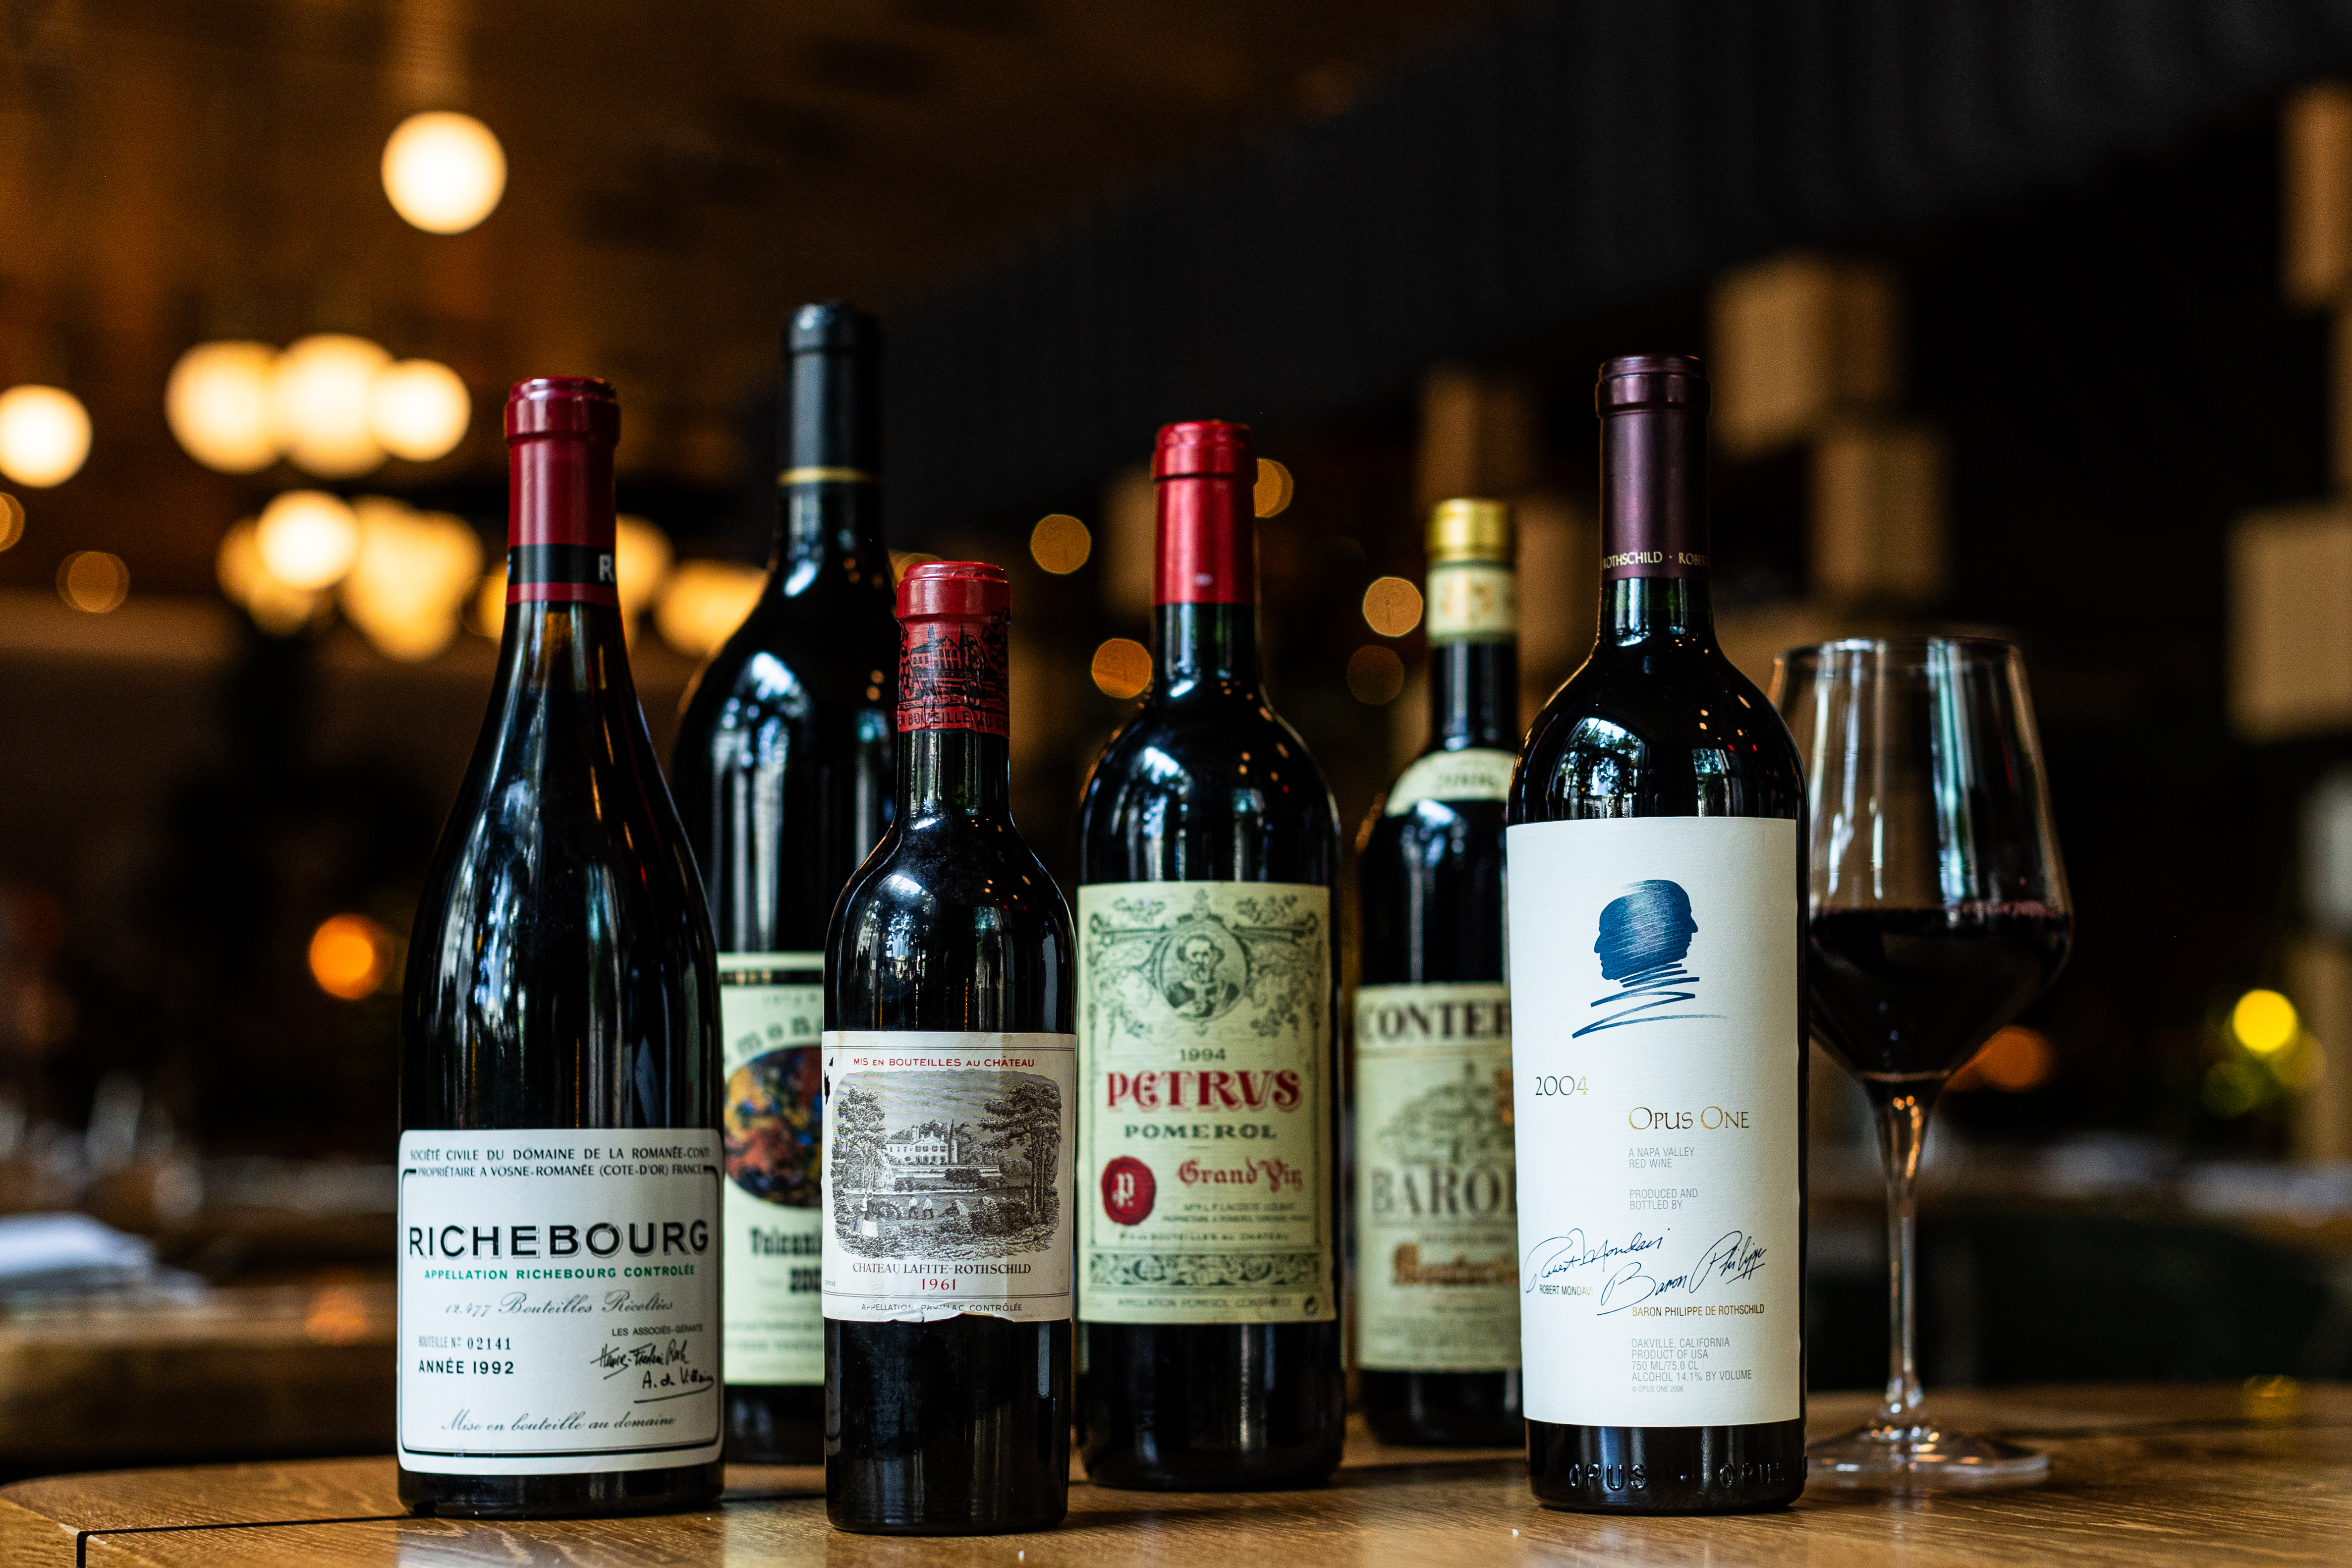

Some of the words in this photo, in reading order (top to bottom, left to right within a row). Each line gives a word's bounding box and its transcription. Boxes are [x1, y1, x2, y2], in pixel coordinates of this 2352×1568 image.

[1603, 551, 1663, 569] ROTHSCHILD
[853, 1058, 868, 1066] MIS
[889, 1058, 962, 1067] BOUTEILLES
[984, 1056, 1035, 1067] CHÂTEAU
[1179, 1048, 1227, 1062] 1994
[1535, 1076, 1588, 1096] 2004
[1629, 1107, 1693, 1130] OPUS
[1700, 1106, 1750, 1130] ONE
[1124, 1123, 1278, 1139] POMEROL
[410, 1147, 441, 1161] SOCIÉTÉ
[446, 1149, 479, 1161] CIVILE
[487, 1149, 504, 1161] DU
[513, 1148, 575, 1160] DOMAINE
[584, 1148, 602, 1160] DE
[609, 1148, 624, 1159] LA
[1629, 1148, 1634, 1158] A
[1637, 1148, 1660, 1158] NAPA
[1663, 1147, 1695, 1157] VALLEY
[418, 1165, 476, 1177] PROPRIÉTAIRE
[480, 1166, 487, 1177] A
[491, 1164, 595, 1177] VOSNE-ROMANÉE
[599, 1164, 669, 1177] (COTE-D'OR)
[672, 1163, 703, 1175] FRANCE
[1629, 1159, 1646, 1169] RED
[1649, 1158, 1673, 1169] WINE
[1176, 1156, 1258, 1187] Grand
[1258, 1158, 1303, 1193] Vin
[1629, 1189, 1677, 1199] PRODUCED
[1680, 1188, 1698, 1198] AND
[1630, 1200, 1669, 1210] BOTTLED
[1671, 1199, 1683, 1210] BY
[409, 1219, 708, 1260] RICHEBOURG
[424, 1269, 508, 1280] APPELLATION
[516, 1267, 616, 1280] RICHEBOURG
[623, 1262, 695, 1278] CONTRÔLÉE
[852, 1262, 901, 1274] CHATEAU
[903, 1263, 1031, 1275] LAFITE-ROTHSCHILD
[921, 1278, 957, 1290] 1961
[1539, 1284, 1560, 1295] ROBERT
[1561, 1285, 1593, 1296] MONDAVI
[498, 1291, 593, 1314] Bouteilles
[969, 1302, 1022, 1311] CONTRÔLÉE
[1632, 1306, 1662, 1317] BARON
[1664, 1306, 1703, 1317] PHILIPPE
[1705, 1305, 1716, 1316] DE
[1718, 1303, 1765, 1316] ROTHSCHILD
[612, 1328, 629, 1337] LES
[418, 1335, 448, 1348] BOUTEILLE
[467, 1336, 511, 1350] 02141
[1631, 1338, 1677, 1349] OAKVILLE,
[1679, 1337, 1730, 1347] CALIFORNIA
[1631, 1349, 1674, 1359] PRODUCT
[1677, 1349, 1688, 1359] OF
[1691, 1349, 1709, 1359] USA
[418, 1356, 464, 1374] ANNÉE
[473, 1360, 514, 1374] 1992
[1631, 1361, 1647, 1370] 750
[1650, 1360, 1685, 1370] ML/75.0
[1687, 1360, 1699, 1370] CL
[1631, 1372, 1673, 1382] ALCOHOL
[1677, 1371, 1703, 1381] 14.1%
[1706, 1371, 1717, 1381] BY
[1719, 1369, 1752, 1380] VOLUME
[441, 1408, 482, 1431] Mise
[486, 1421, 505, 1431] en
[510, 1410, 586, 1431] bouteille
[588, 1418, 610, 1429] au
[613, 1410, 675, 1429] domaine
[1569, 1463, 1647, 1490] OPUS
[1719, 1462, 1786, 1488] OPUS
